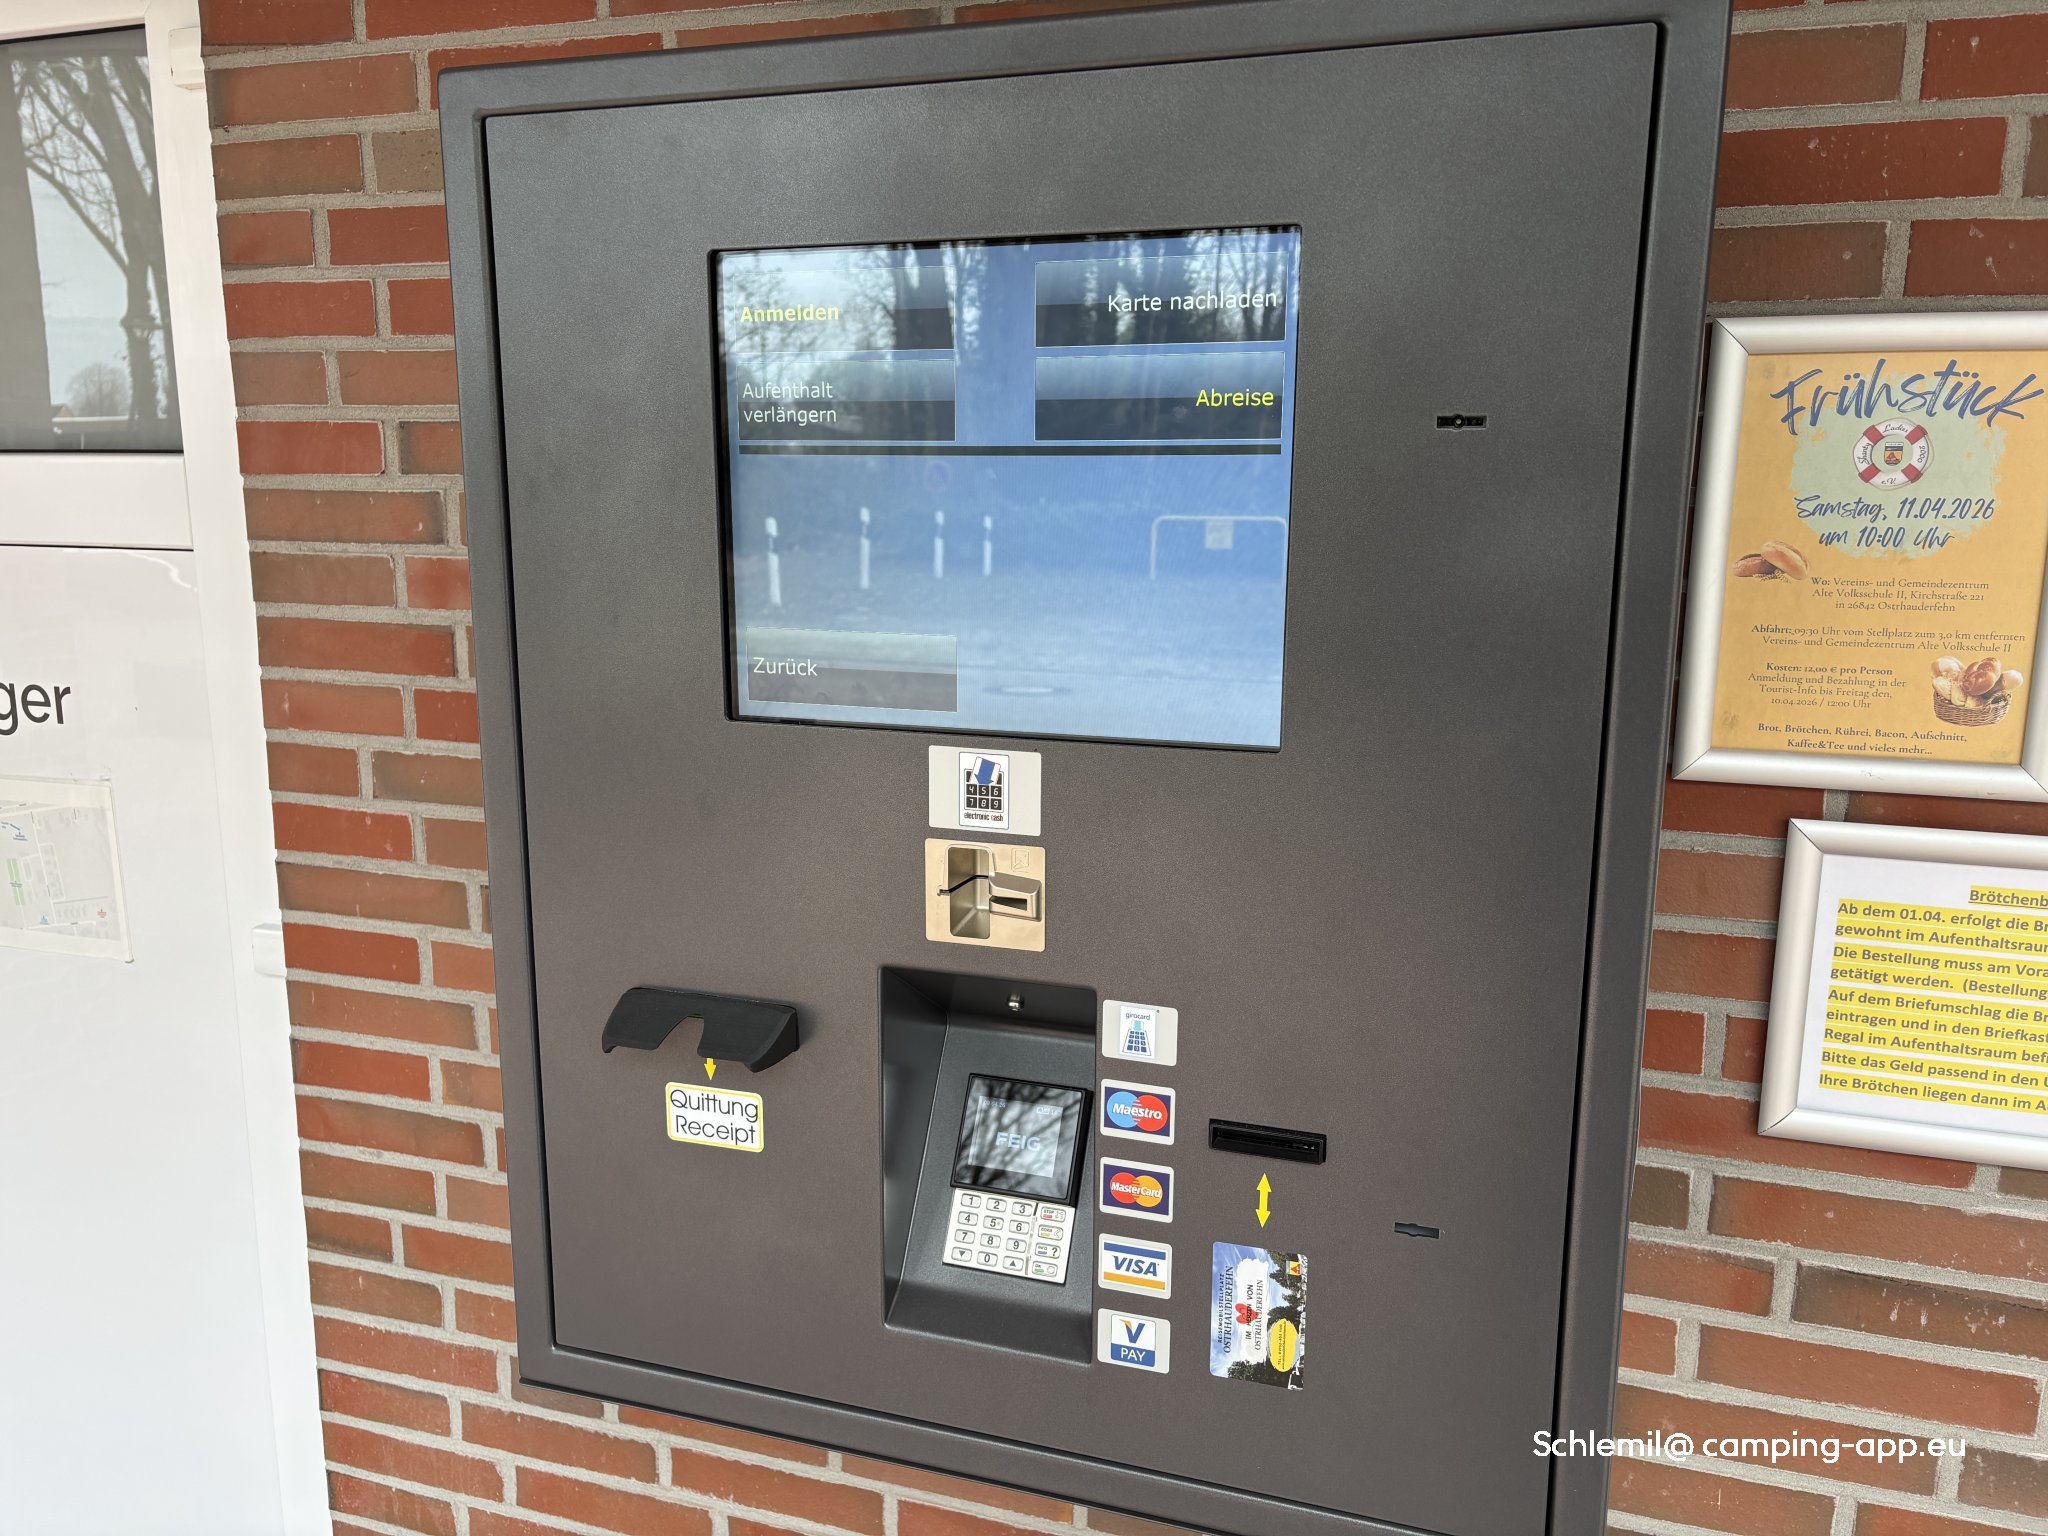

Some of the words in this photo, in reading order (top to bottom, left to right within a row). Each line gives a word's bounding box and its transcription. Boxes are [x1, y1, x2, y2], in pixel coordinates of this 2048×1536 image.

[1108, 293, 1161, 312] Karte
[1170, 290, 1277, 311] nachladen
[740, 303, 839, 323] Anmelden
[743, 381, 833, 399] Aufenthalt
[1196, 390, 1274, 407] Abreise
[1770, 358, 2044, 435] Frühstück
[744, 404, 836, 426] verlängern
[1794, 495, 1887, 523] Samstag,
[1897, 497, 1995, 519] 11.04.2026
[1819, 529, 1848, 547] um
[1857, 526, 1906, 548] 10:00
[1913, 526, 1955, 549] Uhr
[1811, 577, 1830, 586] Wo:
[1834, 578, 1873, 586] Vereins-
[1876, 578, 1895, 587] und
[1898, 579, 1989, 589] Gemeindezentrum
[1812, 588, 1833, 597] Alte
[1837, 589, 1893, 599] Volksschule
[1897, 591, 1907, 600] II,
[1911, 591, 1967, 600] Kirchstraße
[1848, 601, 1874, 610] 26842
[1878, 602, 1955, 611] Ostrhauderfehn
[1823, 627, 1840, 635] Uhr
[1867, 628, 1912, 639] Stellplatz
[1940, 632, 1952, 640] 3,0
[1956, 630, 1970, 639] km
[1974, 631, 2025, 641] entfernten
[1763, 636, 1801, 645] Vereins-
[1826, 638, 1914, 649] Gemeindezentrum
[1918, 641, 1939, 649] Alte
[1943, 642, 2000, 651] Volksschule
[2004, 644, 2011, 652] II
[752, 657, 818, 677] Zurück
[1767, 663, 1801, 672] Kosten:
[1860, 666, 1892, 675] Person
[1748, 673, 1802, 685] Anmeldung
[1827, 676, 1875, 688] Bezahlung
[1891, 678, 1906, 687] der
[1760, 684, 1816, 694] Tourist-Info
[1837, 688, 1869, 698] Freitag
[1820, 698, 1824, 707] /
[1854, 700, 1871, 708] Uhr
[1785, 725, 1831, 734] Brötchen,
[1836, 727, 1871, 736] Rührei,
[1876, 729, 1907, 738] Bacon,
[1911, 731, 1966, 741] Aufschnitt,
[1788, 739, 1844, 749] Kaffee&Tee
[1870, 744, 1895, 752] vieles
[1899, 745, 1932, 754] mehr...
[964, 812, 989, 820] electronic
[1838, 903, 1857, 914] Ab
[1863, 906, 1894, 918] dem
[1900, 909, 1945, 923] 01.04.
[1951, 914, 2001, 929] erfolgt
[2006, 918, 2029, 930] die
[1835, 925, 1901, 939] gewohnt
[1906, 929, 1924, 941] im
[1833, 946, 1857, 958] Die
[1862, 949, 1940, 969] Bestellung
[1944, 960, 1982, 971] muss
[1987, 964, 2011, 974] am
[1830, 966, 1888, 983] getätigt
[1893, 973, 1953, 989] werden.
[1963, 979, 2048, 1000] (Bestellung
[1828, 989, 1854, 1001] Auf
[1858, 993, 1891, 1006] dem
[1896, 997, 2001, 1020] Briefumschlag
[2006, 1008, 2029, 1021] die
[1126, 1012, 1150, 1020] girocard
[1826, 1010, 1897, 1027] eintragen
[1901, 1019, 1929, 1030] und
[1934, 1021, 1948, 1032] in
[1952, 1023, 1979, 1036] den
[1825, 1029, 1864, 1043] Regal
[1868, 1033, 1886, 1045] im
[1891, 1036, 2016, 1061] Aufenthaltsraum
[1822, 1051, 1856, 1065] Bitte
[1861, 1056, 1885, 1068] das
[1890, 1059, 1924, 1073] Geld
[1928, 1064, 1988, 1081] passend
[1993, 1071, 2006, 1082] in
[2011, 1074, 2038, 1086] den
[1820, 1074, 1847, 1087] Ihre
[1852, 1079, 1918, 1096] Brötchen
[1923, 1086, 1966, 1102] liegen
[1971, 1090, 2008, 1106] dann
[2013, 1097, 2031, 1109] im
[670, 1089, 758, 1123] Quittung
[1113, 1104, 1162, 1120] Maestro
[676, 1115, 755, 1145] Receipt
[995, 1131, 1041, 1150] FEIG
[1111, 1182, 1161, 1198] MasterCard
[969, 1197, 973, 1205] 1
[994, 1201, 999, 1209] 2
[1019, 1205, 1025, 1213] 3
[965, 1215, 970, 1223] 4
[990, 1219, 996, 1227] 5
[1016, 1223, 1022, 1231] 6
[962, 1232, 967, 1240] 7
[988, 1237, 993, 1245] 8
[1013, 1241, 1019, 1249] 9
[1112, 1255, 1158, 1276] VISA
[1224, 1266, 1234, 1353] OSTRHAUDERFEHN
[1255, 1280, 1263, 1350] OSTRHAUDERFEHN
[1120, 1319, 1145, 1343] V
[1246, 1329, 1252, 1339] IM
[1121, 1348, 1145, 1362] PAY
